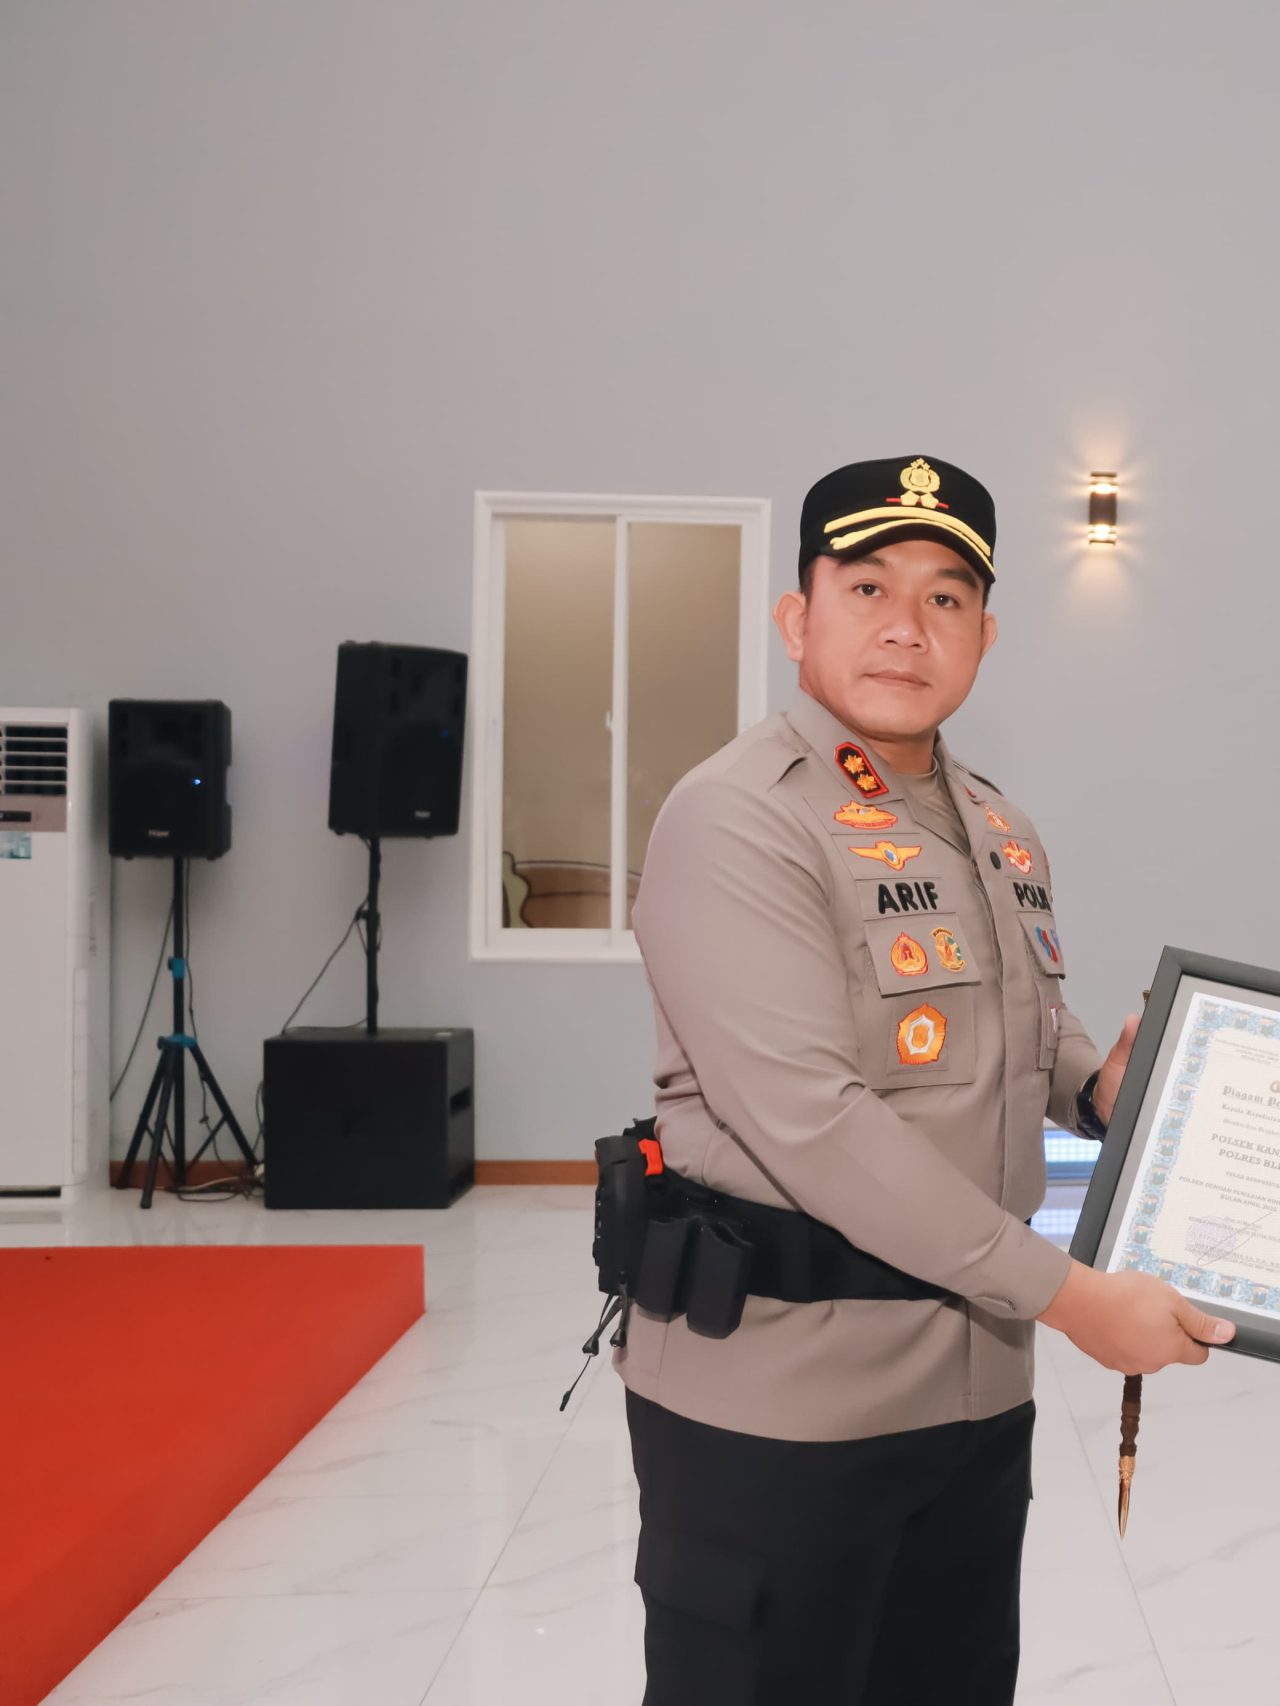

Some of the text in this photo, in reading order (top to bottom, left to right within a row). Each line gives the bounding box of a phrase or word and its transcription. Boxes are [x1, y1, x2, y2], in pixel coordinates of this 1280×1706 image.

[878, 881, 938, 914] ARIF
[1013, 882, 1052, 912] POLR
[1222, 1085, 1264, 1104] Piagam
[1211, 1132, 1254, 1151] POLSEK
[1219, 1148, 1261, 1165] POLRES
